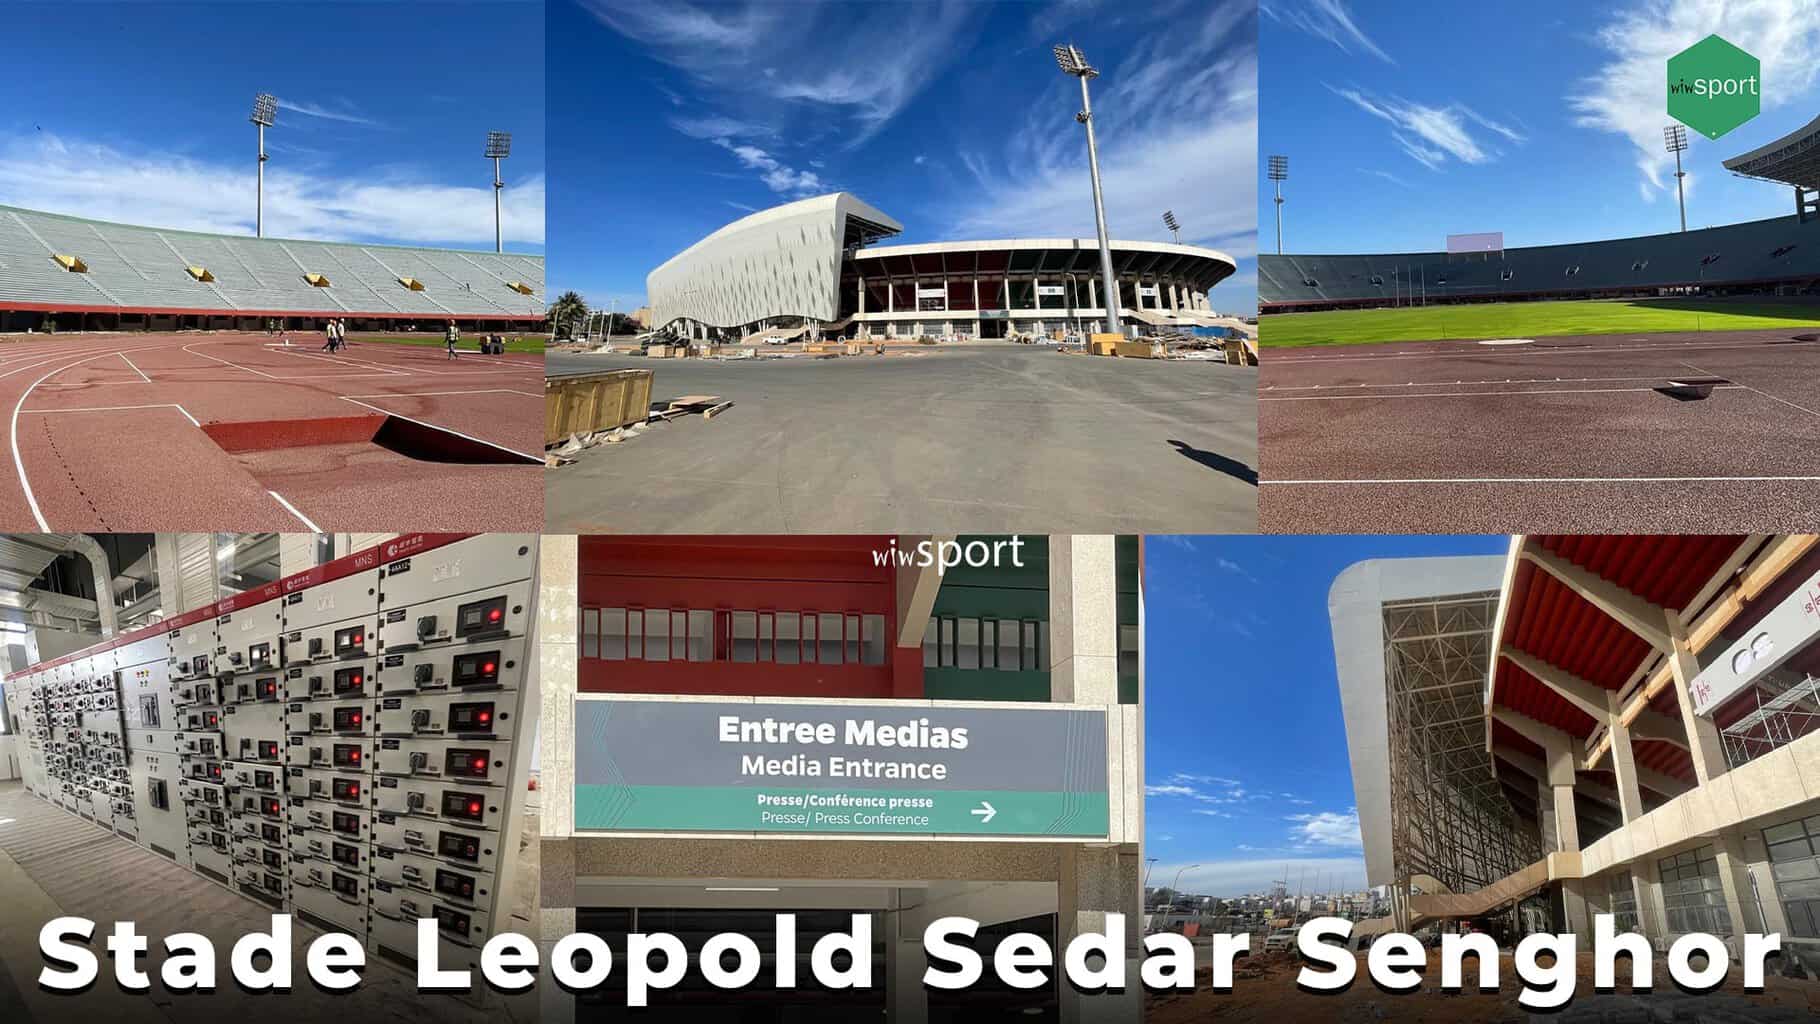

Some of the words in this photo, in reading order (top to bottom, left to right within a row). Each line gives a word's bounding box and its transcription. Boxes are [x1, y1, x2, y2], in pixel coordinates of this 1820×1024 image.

[719, 715, 836, 744] Entree
[844, 717, 969, 750] Medias
[741, 754, 822, 777] Media
[829, 756, 947, 780] Entrance
[757, 794, 887, 809] Presse/Conférence
[889, 797, 934, 809] presse
[761, 811, 811, 827] Presse/
[815, 812, 850, 825] Press
[853, 812, 929, 826] Conference
